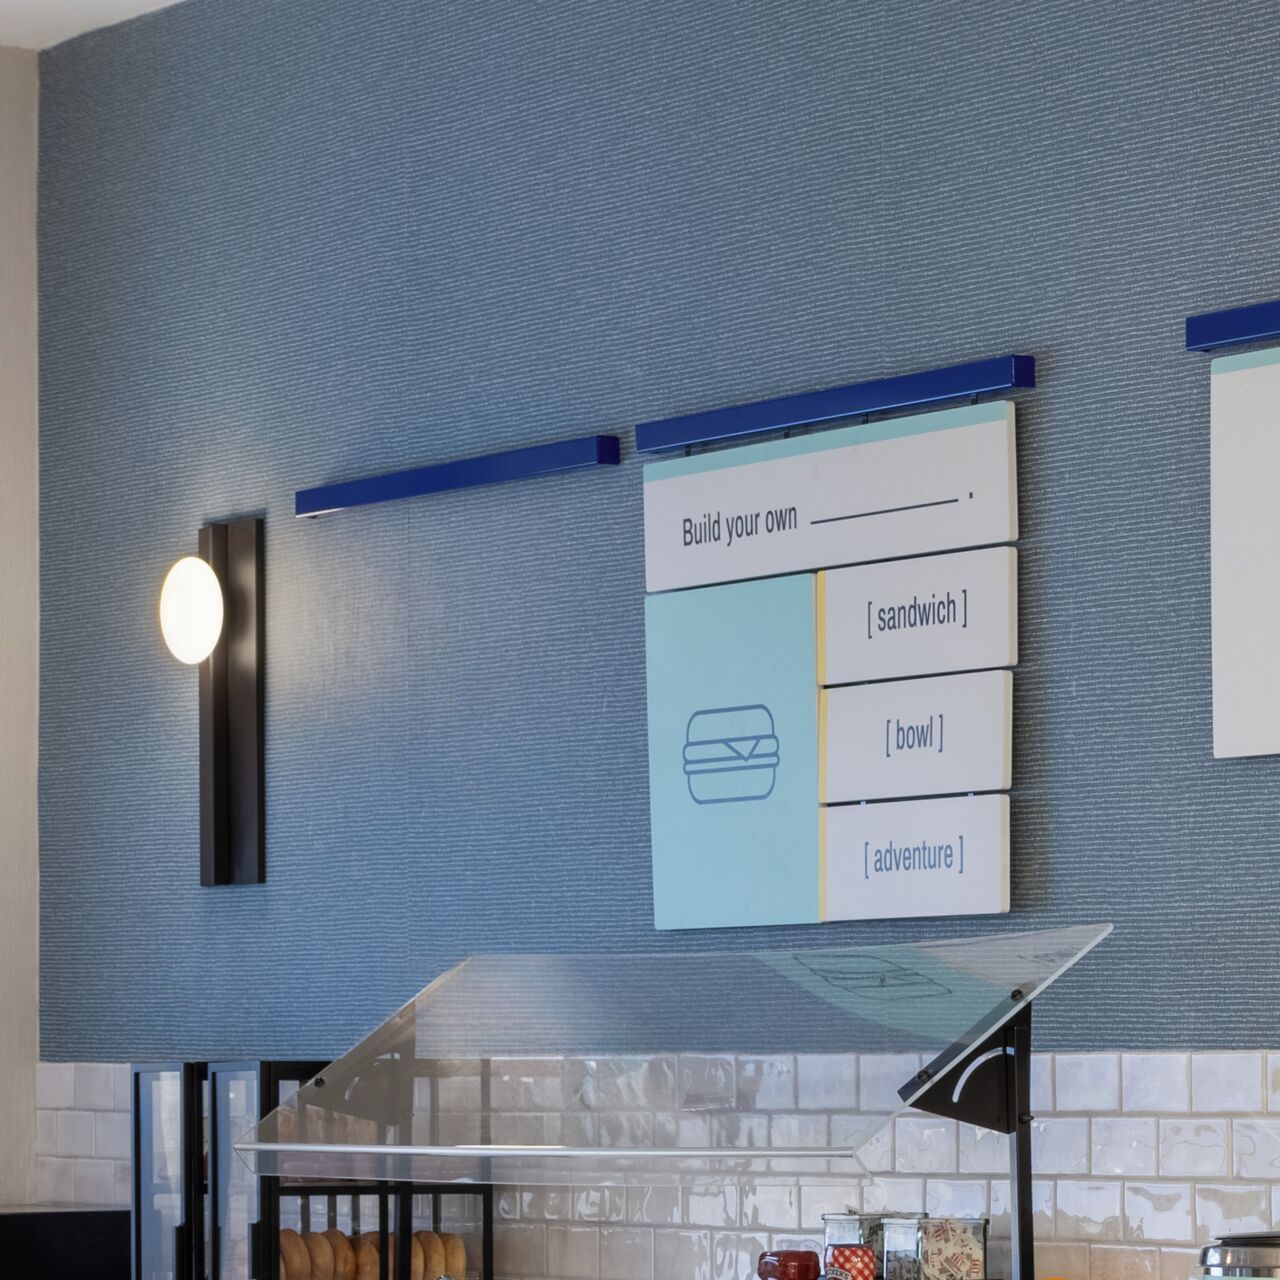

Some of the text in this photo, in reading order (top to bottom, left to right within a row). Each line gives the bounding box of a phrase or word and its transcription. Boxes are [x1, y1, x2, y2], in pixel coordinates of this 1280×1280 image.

[682, 506, 798, 547] Build your own
